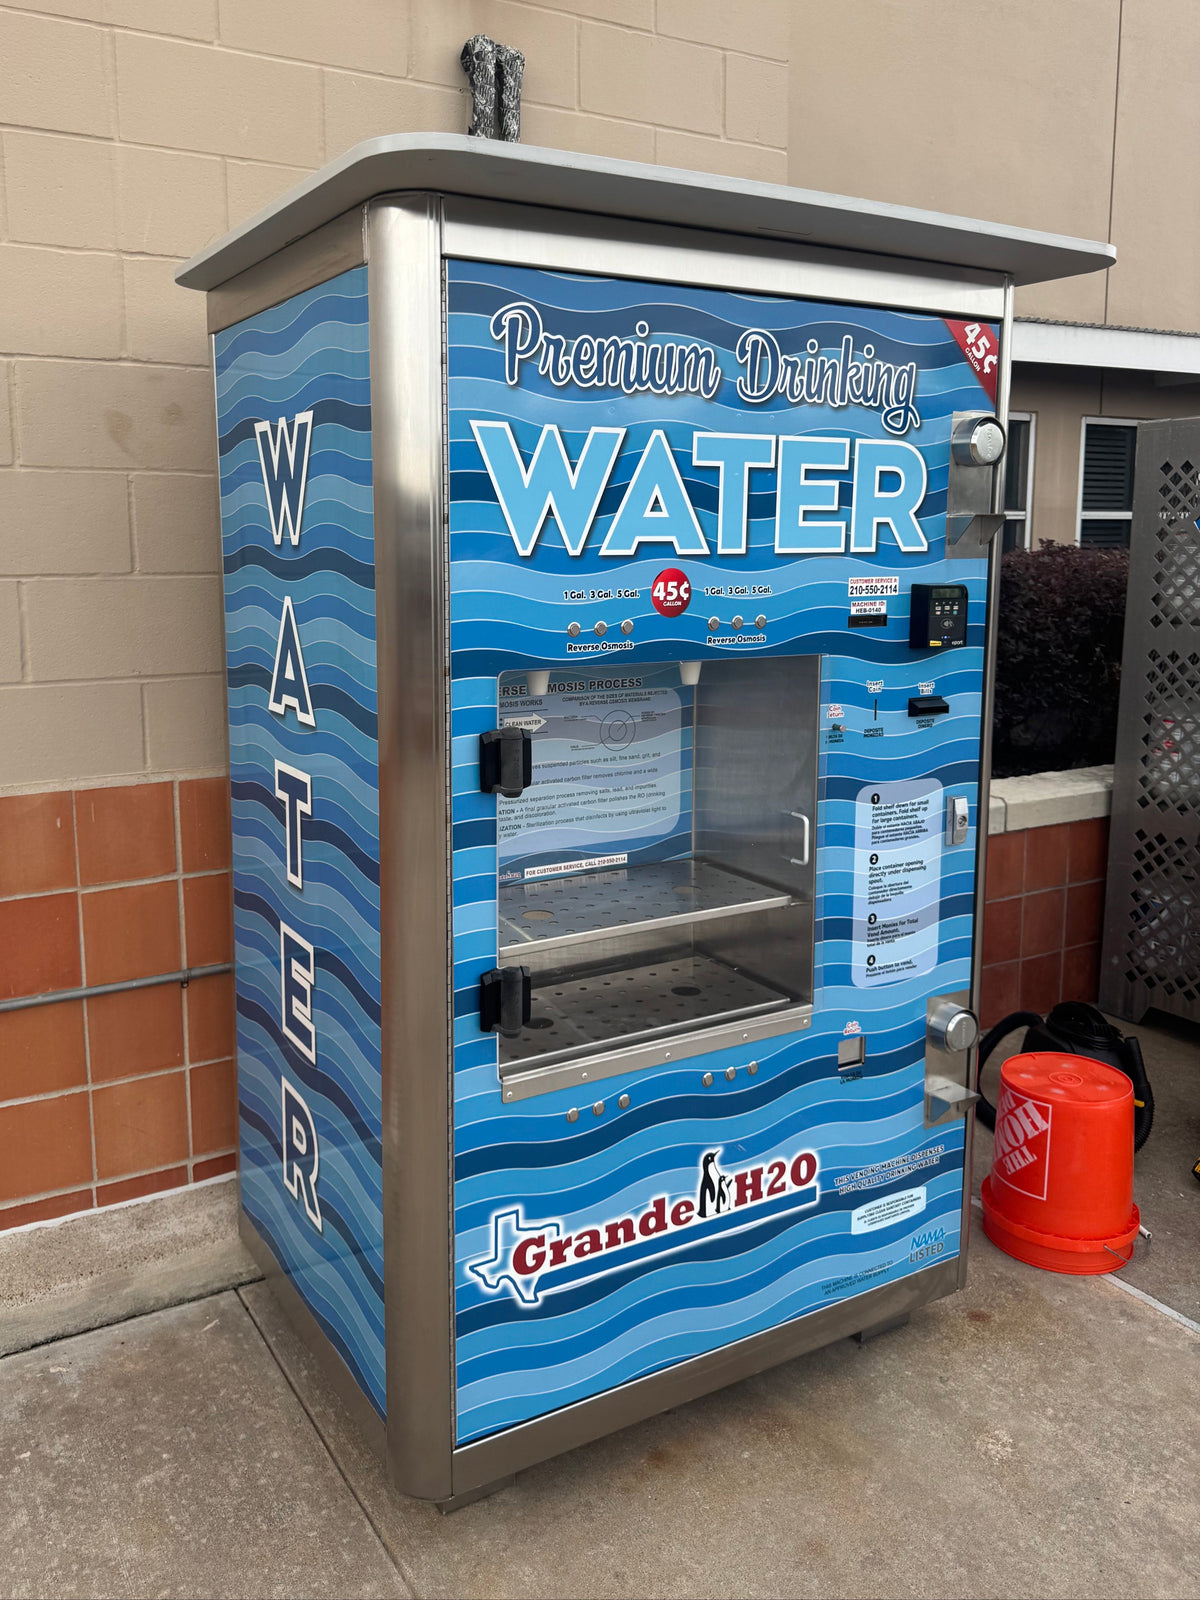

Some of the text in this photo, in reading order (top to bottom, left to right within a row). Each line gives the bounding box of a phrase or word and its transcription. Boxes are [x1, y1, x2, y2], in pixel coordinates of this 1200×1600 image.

[964, 323, 998, 374] 45¢
[490, 301, 919, 434] Premium Drinking
[965, 347, 981, 372] GALLON
[469, 419, 928, 556] WATER
[564, 590, 639, 600] 1 Gal. 3 Gal. 5 Gal.
[653, 581, 690, 601] 45¢
[710, 587, 725, 595] Gal.
[734, 587, 749, 595] Gal.
[752, 586, 757, 594] 5
[757, 586, 772, 594] Gal.
[850, 585, 898, 595] 210-550-2114
[567, 641, 634, 652] Reverse Osmosis
[707, 635, 767, 645] Reverse Osmosis
[547, 680, 585, 693] MOSIS
[589, 677, 642, 690] PROCESS
[520, 699, 543, 707] WORKS
[542, 761, 569, 769] suspended
[541, 777, 564, 785] activated
[254, 410, 322, 1233] WATER
[871, 855, 877, 863] 2
[537, 866, 562, 875] CUSTOMER
[902, 865, 927, 873] dispensing
[870, 915, 875, 923] 3
[869, 956, 874, 964] 4
[994, 1100, 1049, 1162] HOM
[835, 1145, 944, 1186] THIS VENDING MACHINE DISPENSES
[1002, 1146, 1037, 1175] THE
[839, 1156, 940, 1195] HIGH QUALITY DRINKING WATER
[512, 1197, 695, 1276] Grande
[910, 1227, 946, 1250] NAMA
[909, 1242, 944, 1263] LISTED
